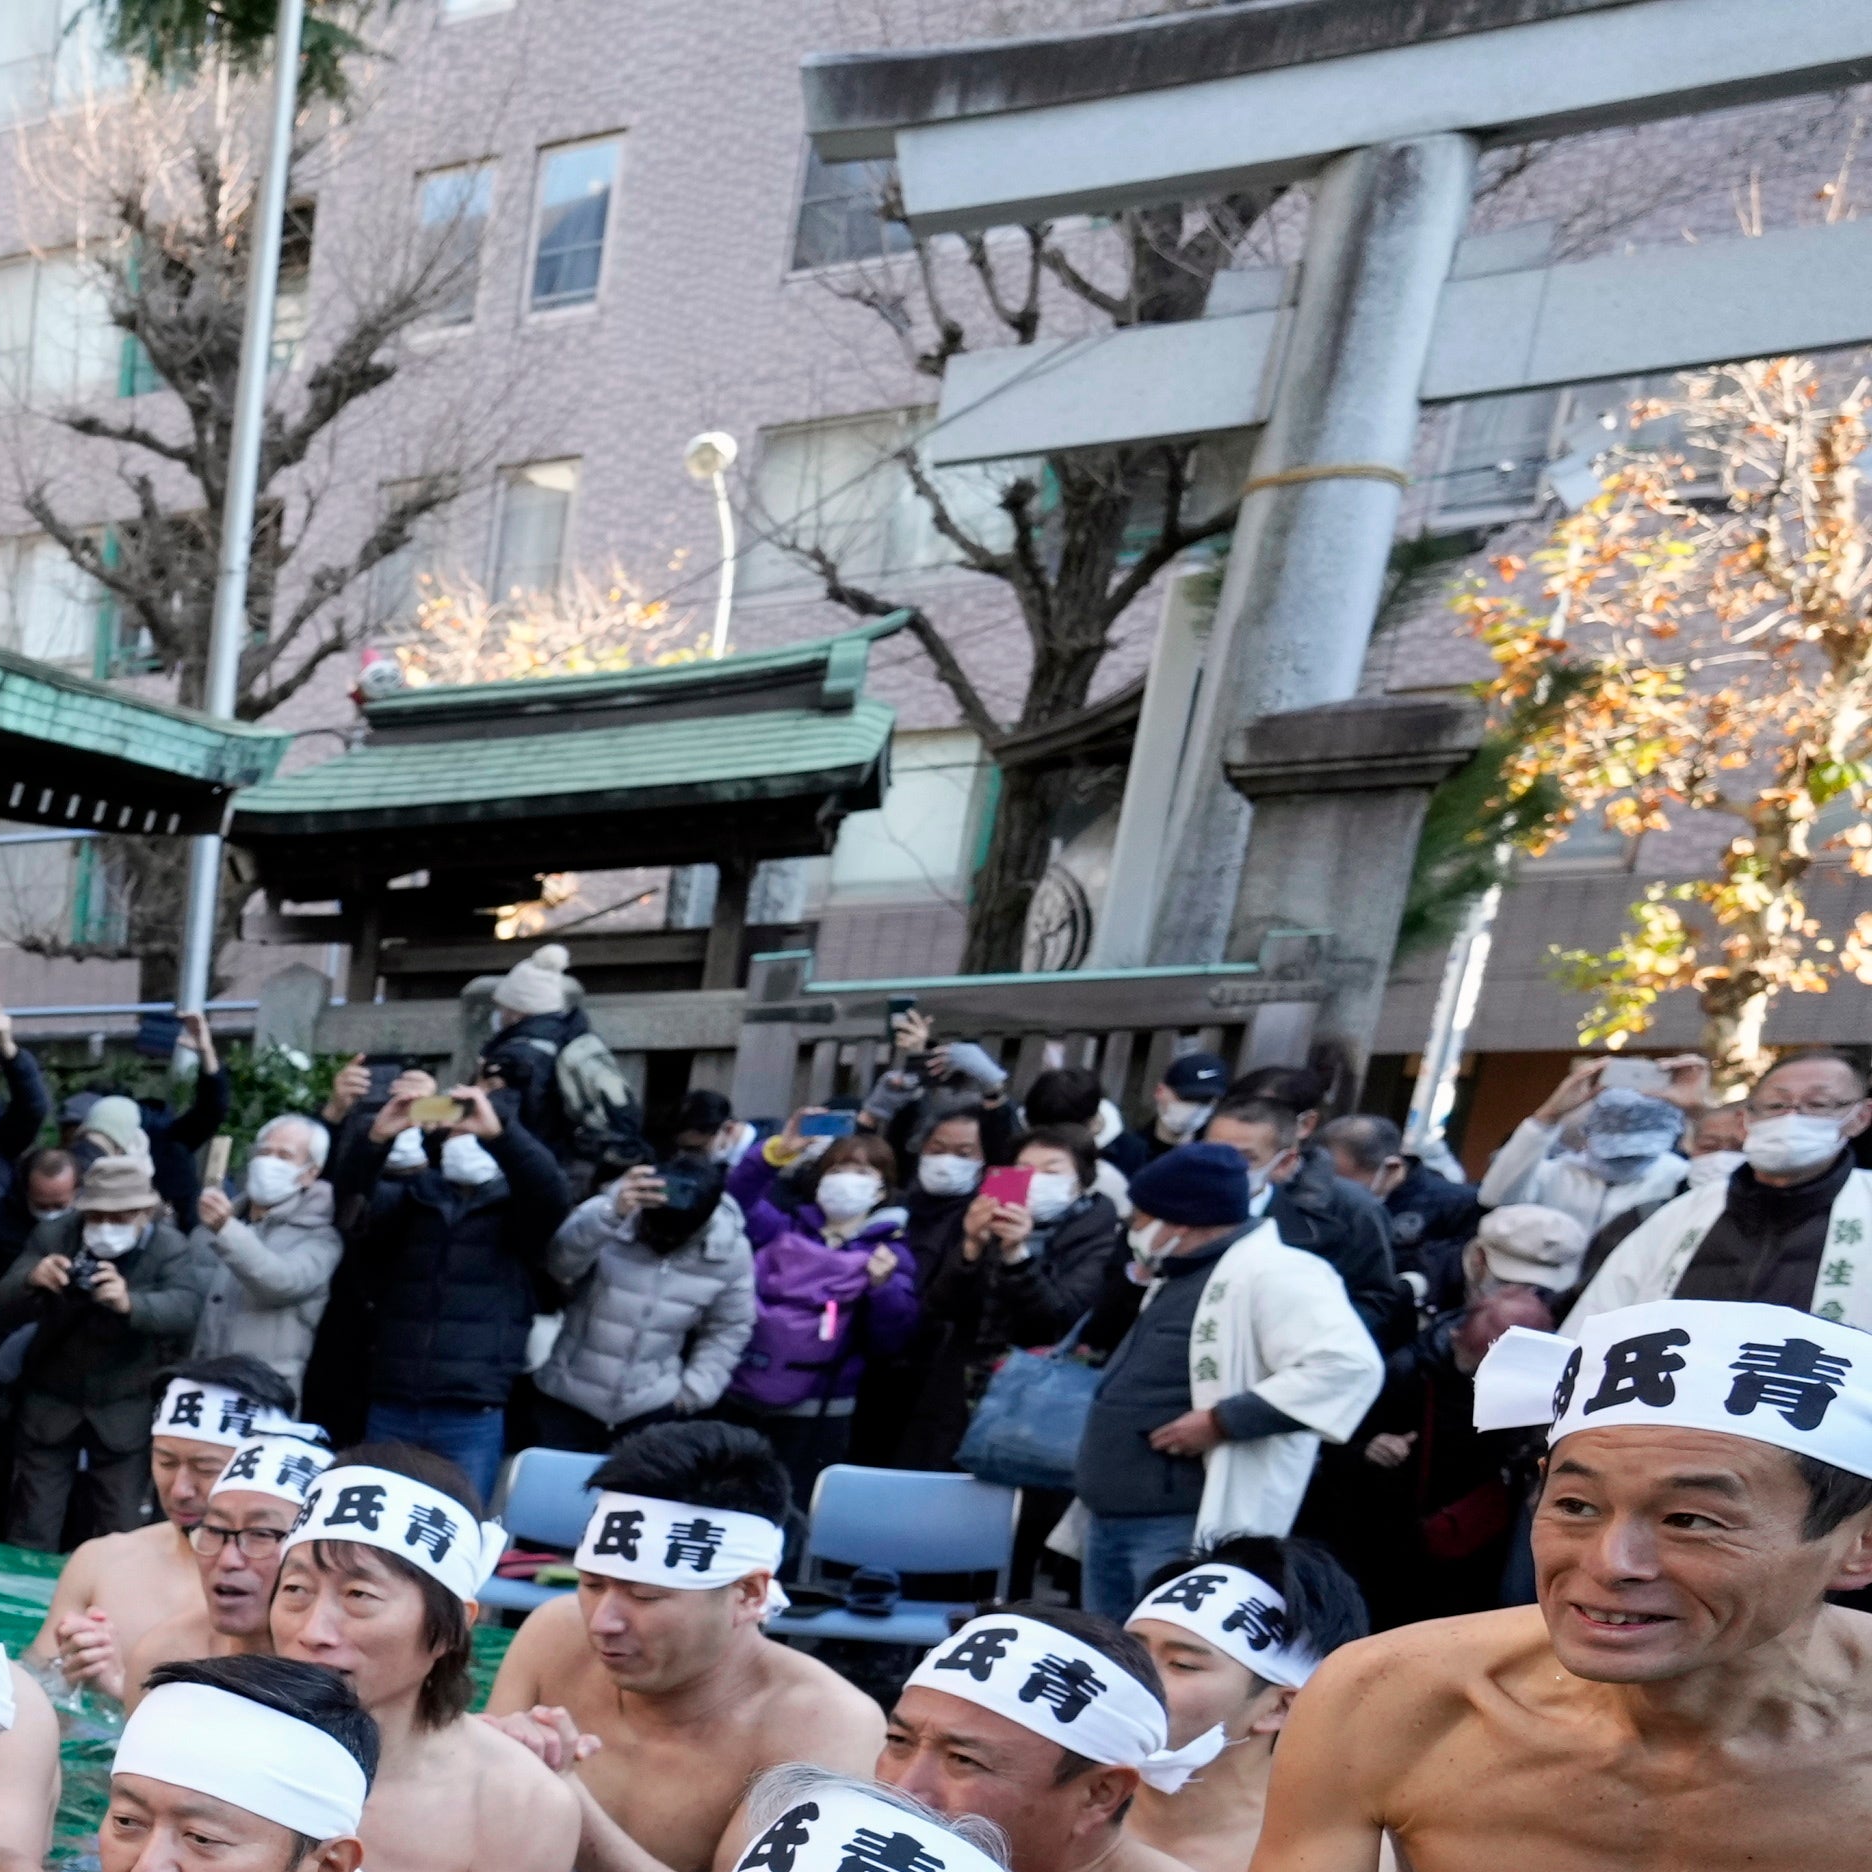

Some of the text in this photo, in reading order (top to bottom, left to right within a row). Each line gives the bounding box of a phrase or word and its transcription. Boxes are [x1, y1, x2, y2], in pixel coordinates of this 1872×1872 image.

[593, 1509, 726, 1573] 氏青
[1152, 1574, 1292, 1652] 氏青
[935, 1628, 1107, 1724] 氏青
